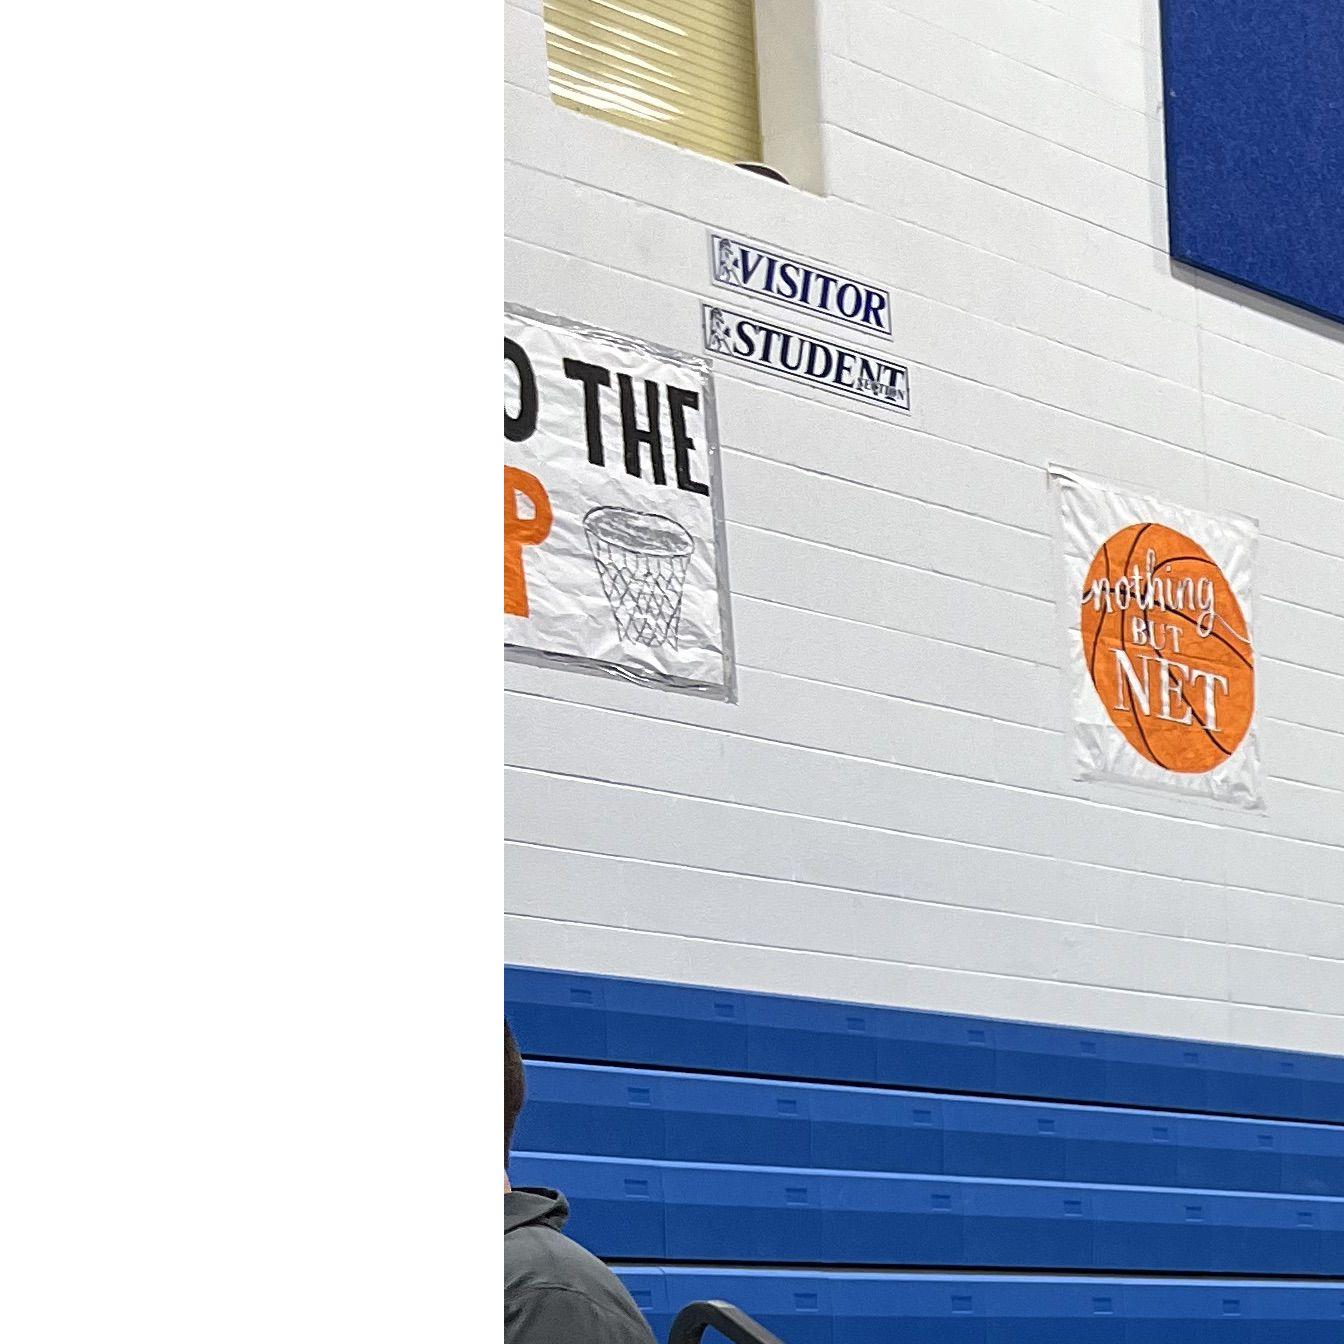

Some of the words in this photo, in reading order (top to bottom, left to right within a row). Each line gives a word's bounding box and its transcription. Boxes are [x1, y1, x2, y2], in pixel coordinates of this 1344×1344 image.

[738, 249, 886, 328] VISITOR
[732, 320, 905, 402] STUDENT
[562, 357, 710, 497] THE
[1081, 548, 1251, 643] nothing
[1131, 616, 1183, 653] BUT
[1108, 647, 1229, 733] NET
